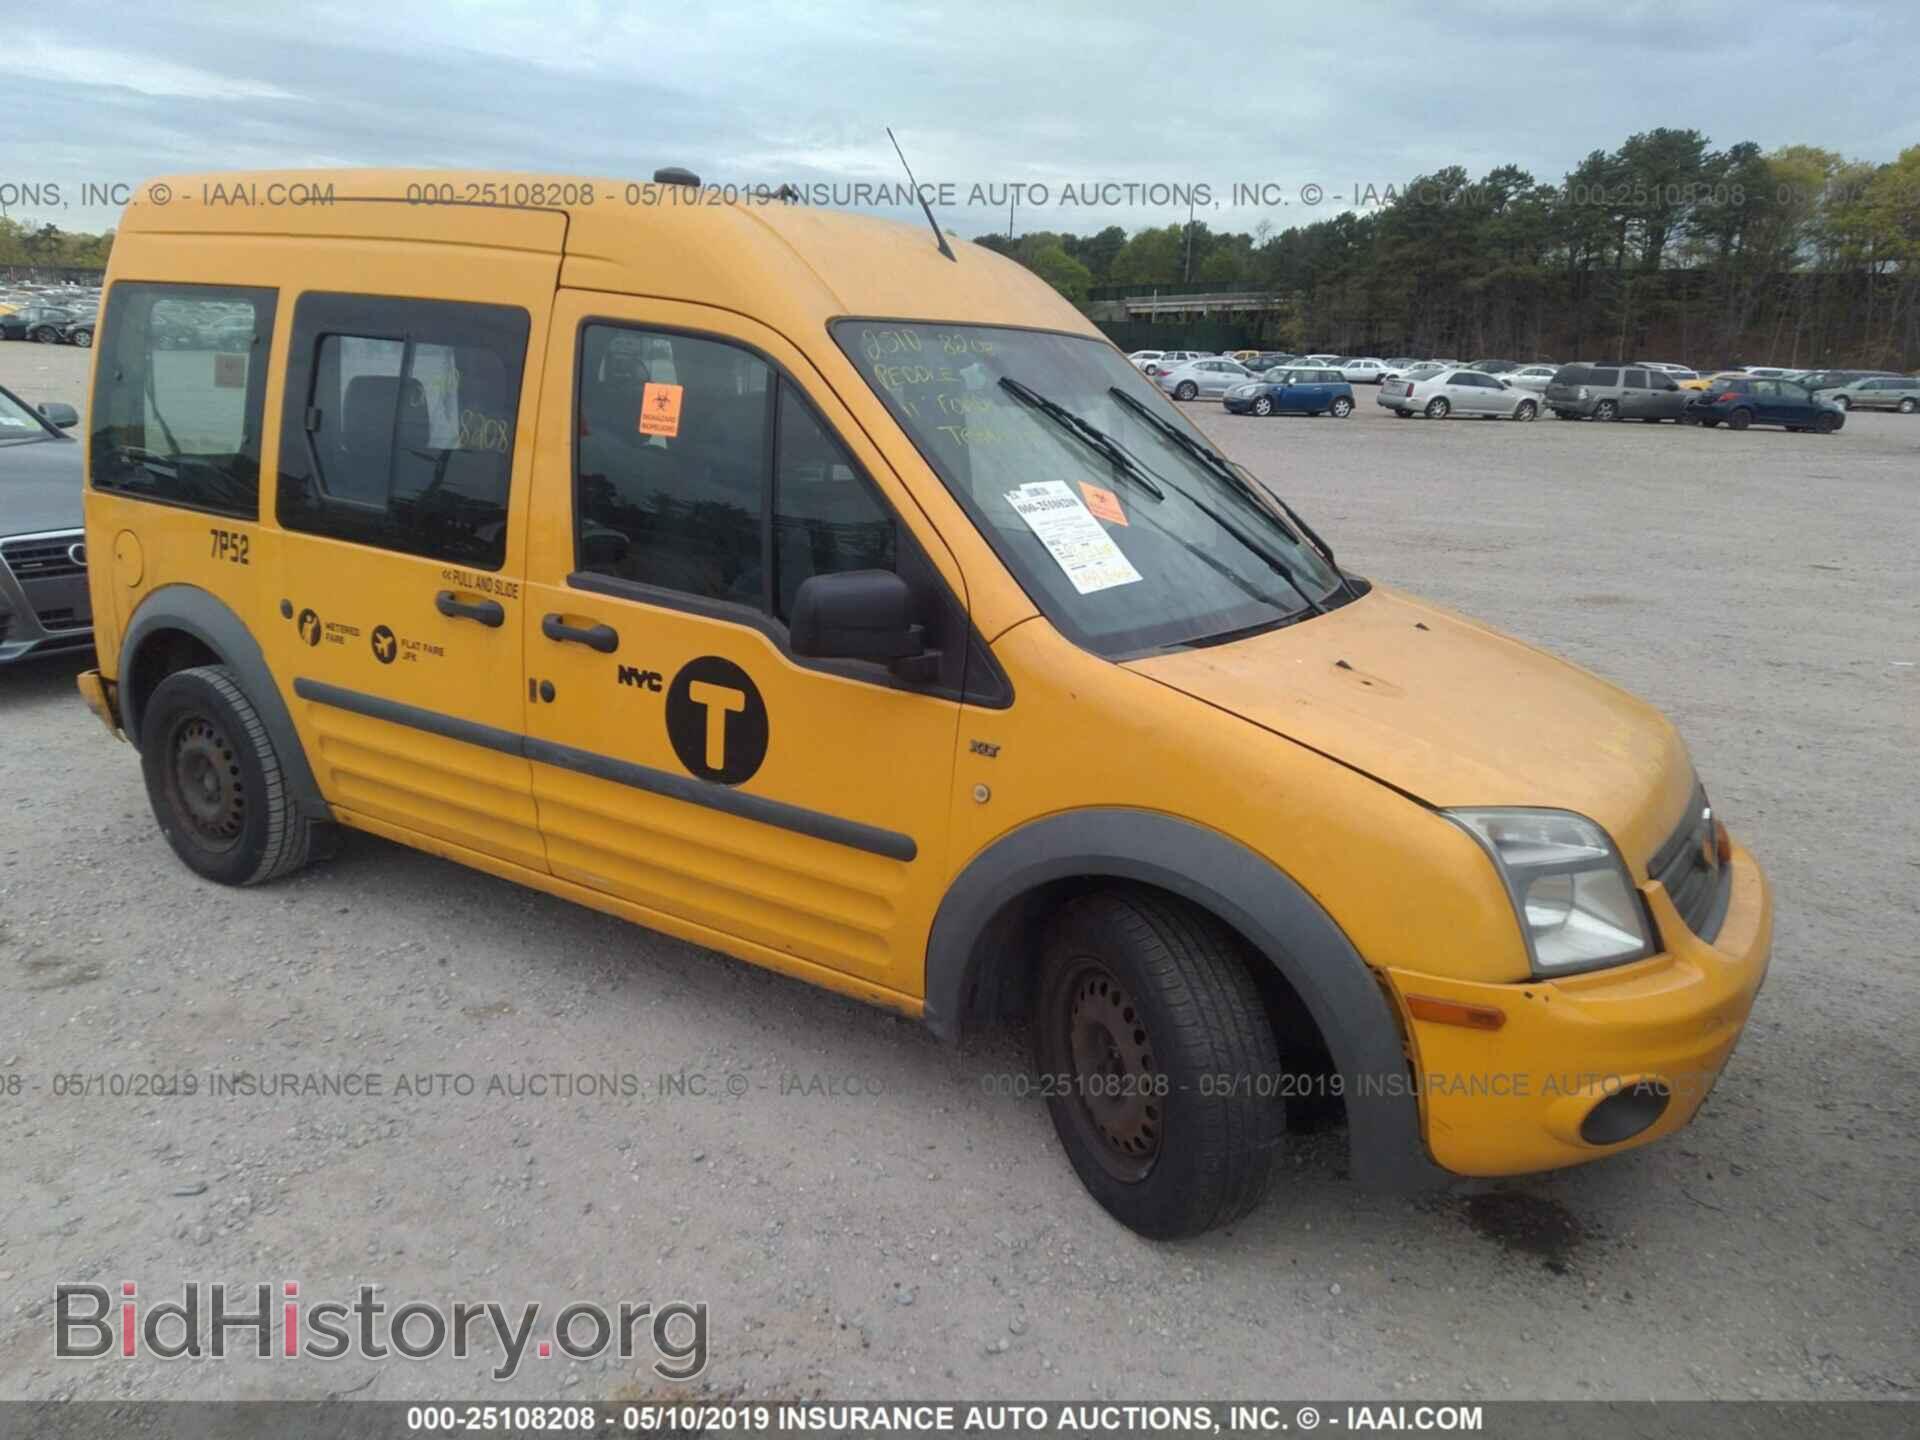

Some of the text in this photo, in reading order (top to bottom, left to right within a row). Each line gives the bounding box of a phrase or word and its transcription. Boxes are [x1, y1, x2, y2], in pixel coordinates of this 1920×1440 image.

[210, 528, 249, 565] 7P52
[453, 568, 519, 600] PULL AND SLIDE
[618, 664, 662, 693] NYC
[689, 679, 745, 771] T
